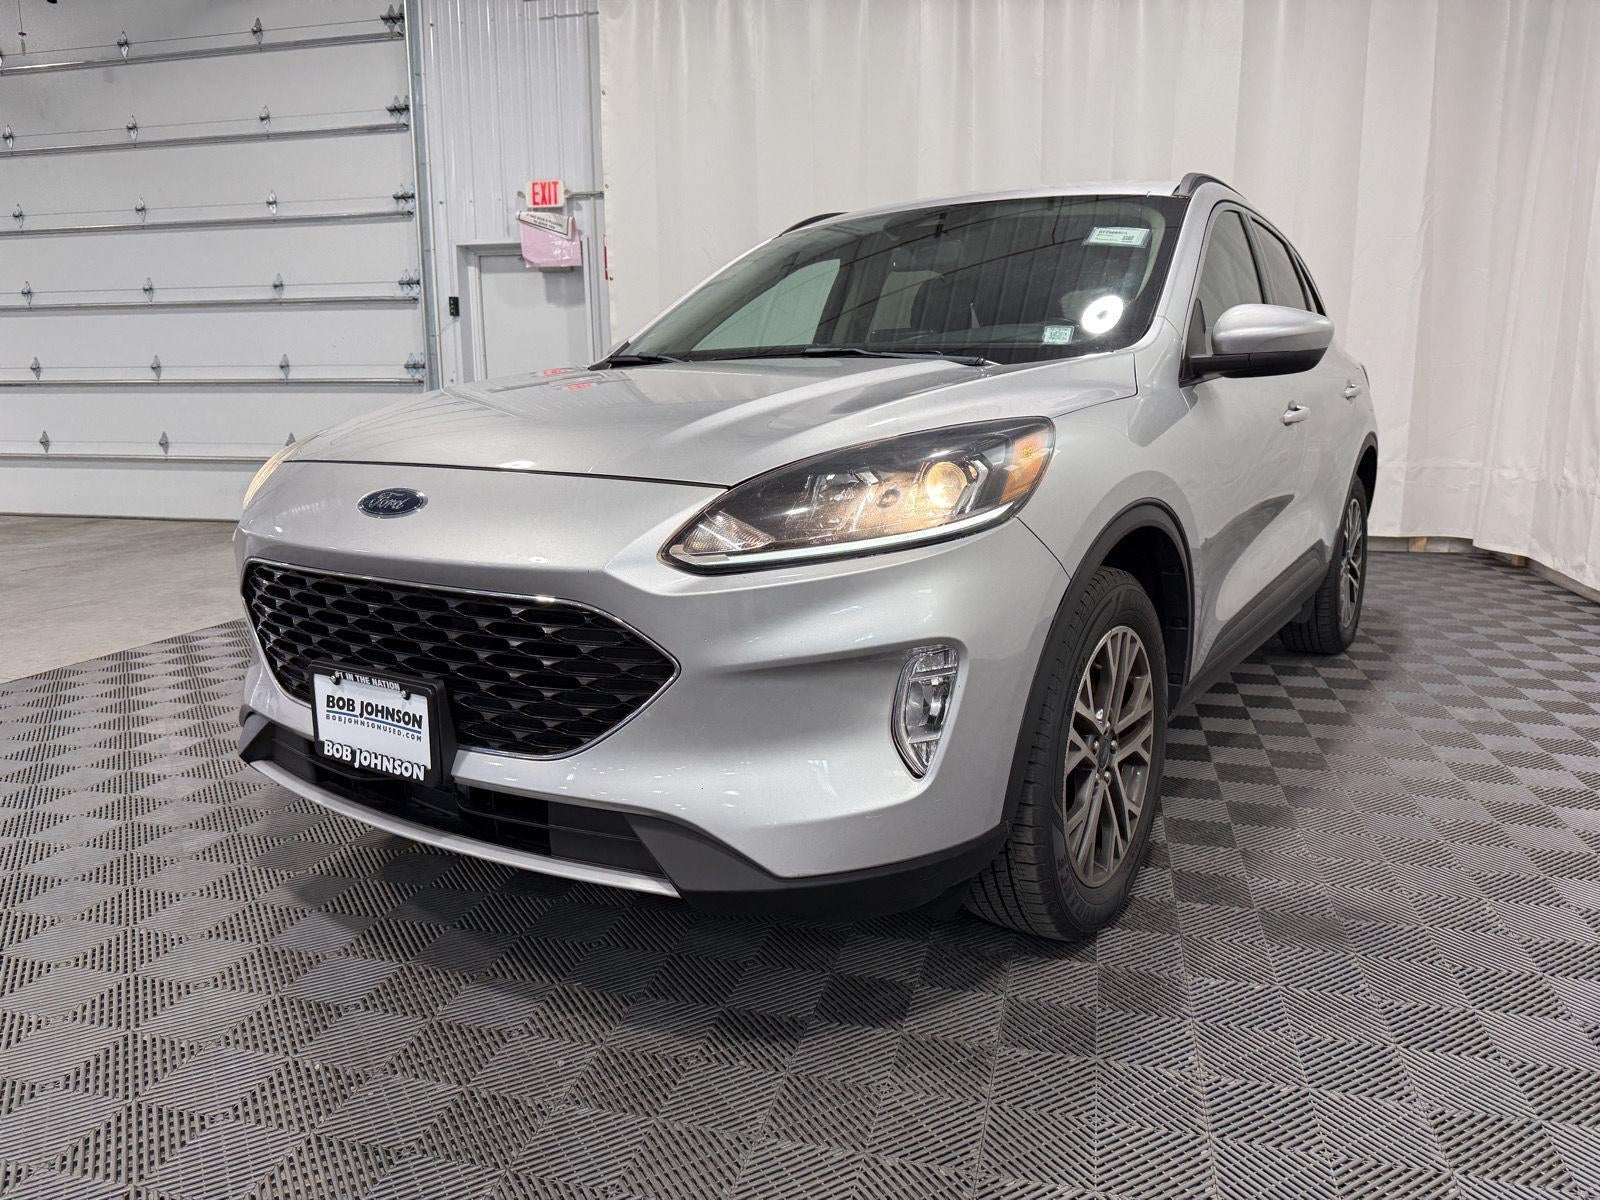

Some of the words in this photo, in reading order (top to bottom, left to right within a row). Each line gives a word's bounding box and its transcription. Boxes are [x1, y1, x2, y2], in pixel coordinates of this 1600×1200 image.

[531, 181, 559, 206] EXIT
[368, 492, 410, 510] Ford
[345, 673, 354, 682] IN
[356, 674, 371, 685] THE
[372, 678, 400, 691] NATION
[326, 694, 356, 713] BOB
[358, 700, 423, 730] JOHNSON
[325, 713, 422, 743] BOBJOHNSONUSED.COM
[323, 740, 352, 762] BOB
[354, 748, 425, 781] JOHNSON
